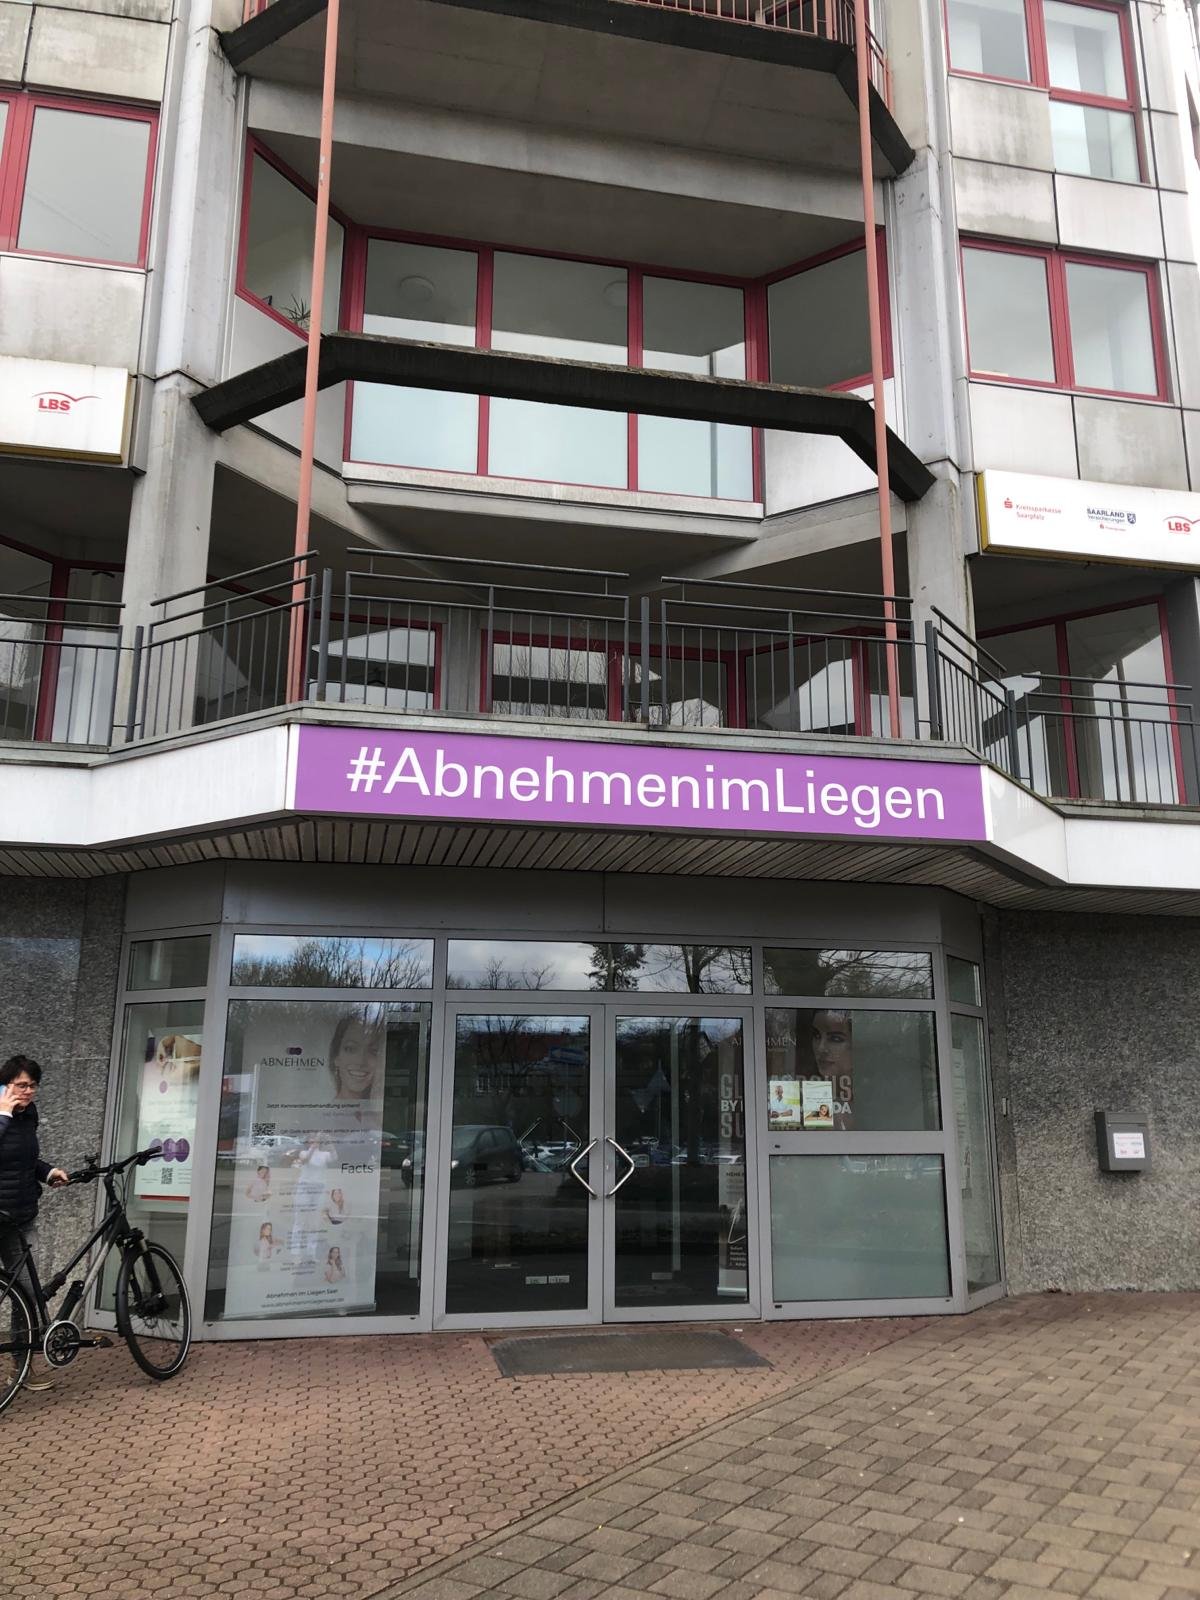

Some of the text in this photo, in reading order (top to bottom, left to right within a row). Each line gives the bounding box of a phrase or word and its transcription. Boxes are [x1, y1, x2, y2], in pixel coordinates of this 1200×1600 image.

[38, 397, 71, 411] LBS
[1087, 508, 1125, 519] SAARLAND
[1168, 521, 1191, 533] LBS
[346, 746, 946, 828] #AbnehmenimLiegen
[261, 1057, 325, 1067] ABNEHMEN
[341, 1162, 374, 1175] Facts
[266, 1291, 298, 1299] Abnehmen
